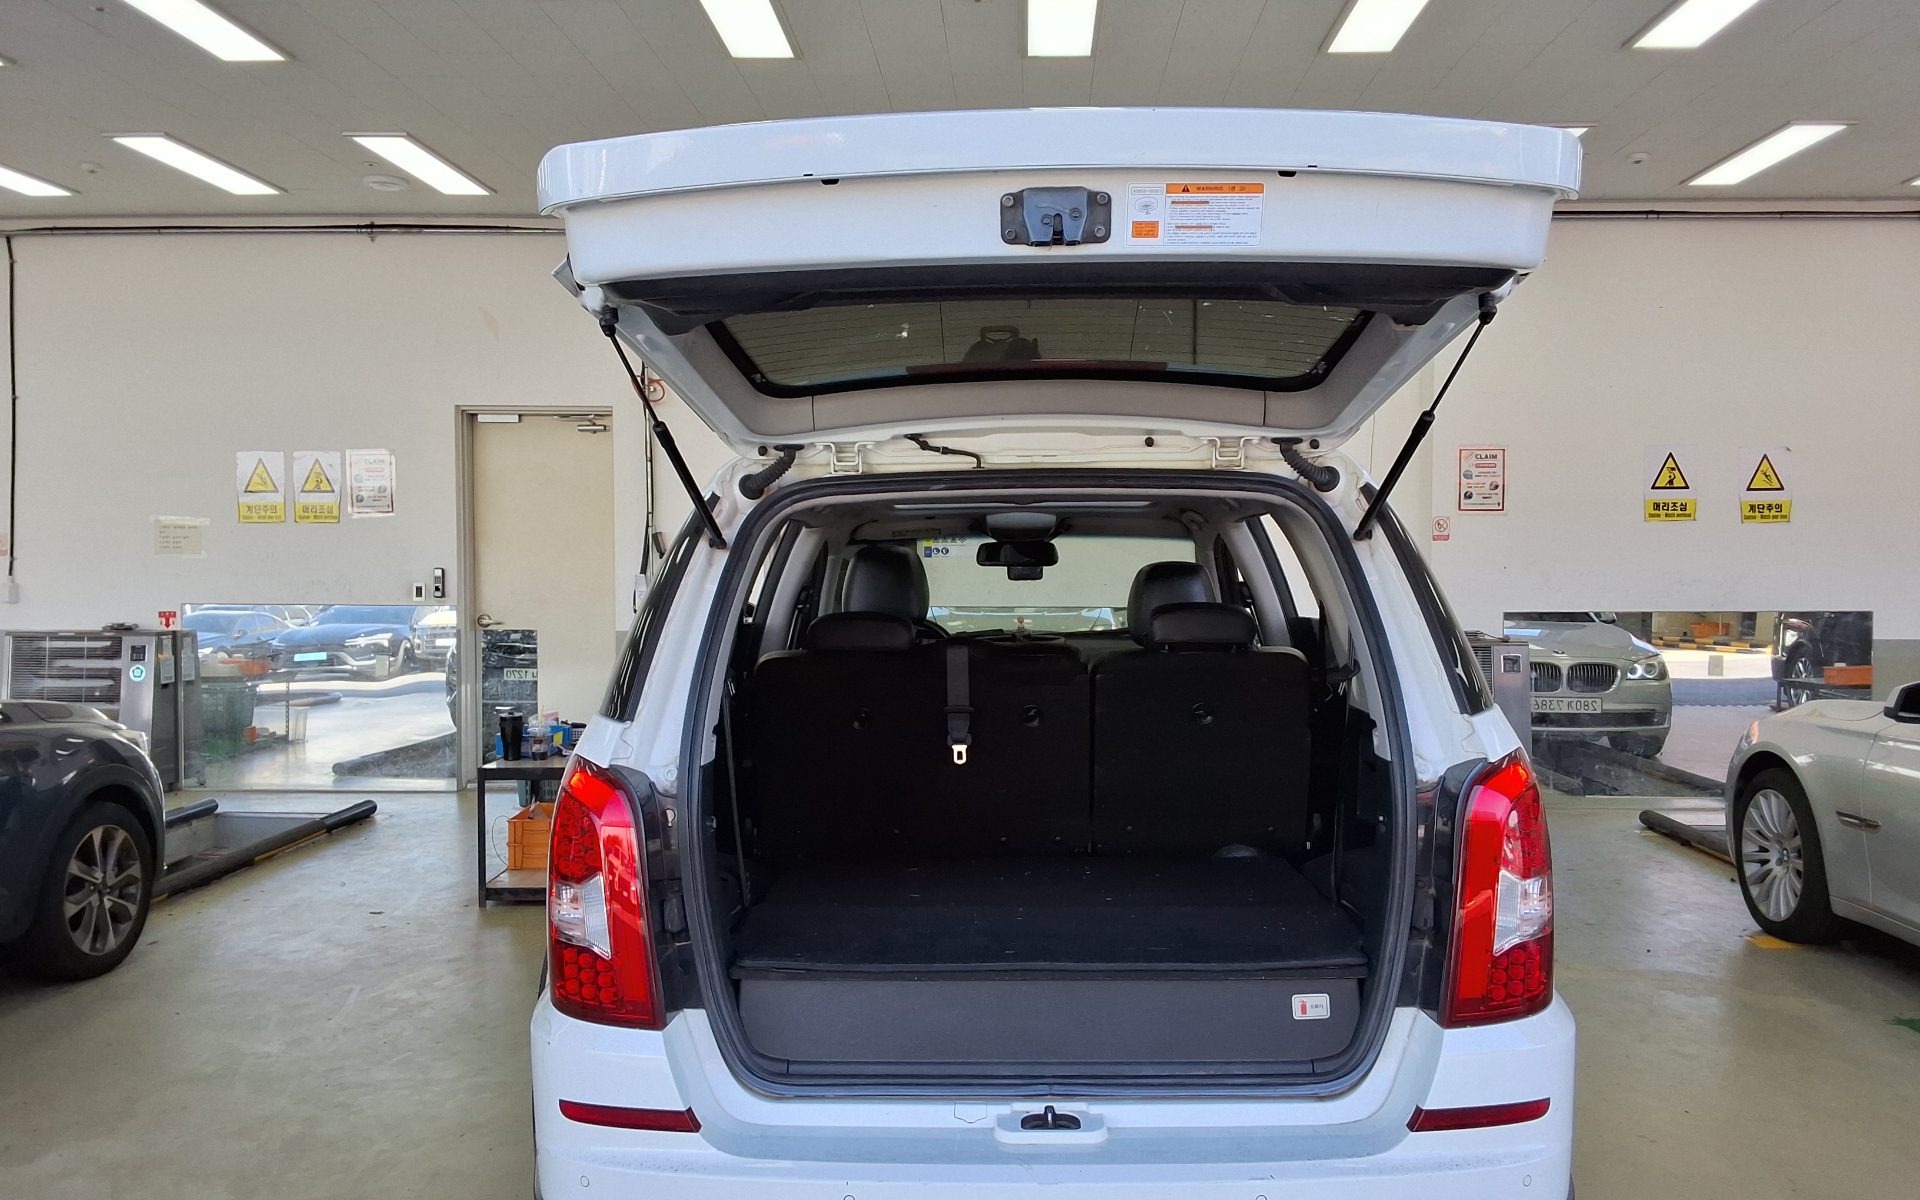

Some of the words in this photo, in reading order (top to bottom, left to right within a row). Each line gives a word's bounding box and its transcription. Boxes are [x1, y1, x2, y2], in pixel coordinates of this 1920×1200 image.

[246, 504, 277, 514] 계단주의
[302, 504, 334, 514] 머리조심
[1653, 502, 1687, 511] 머리조심
[1748, 503, 1783, 513] 계단주의
